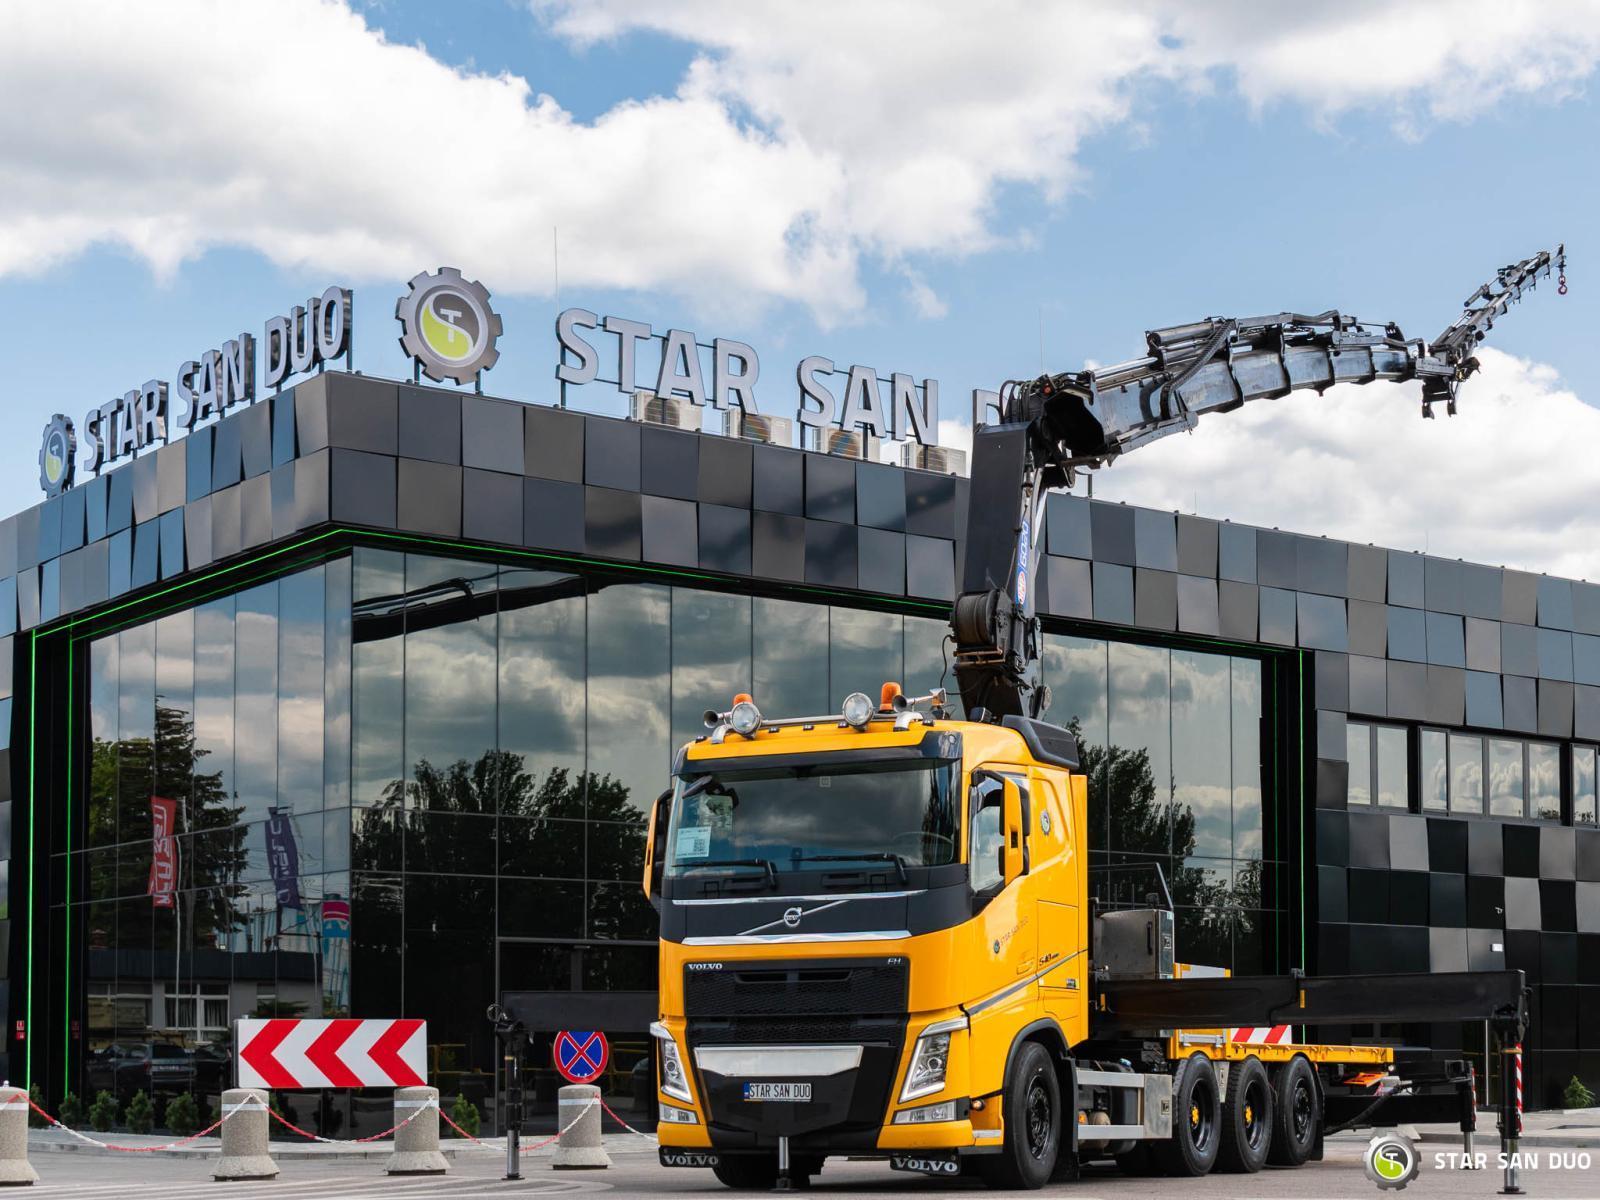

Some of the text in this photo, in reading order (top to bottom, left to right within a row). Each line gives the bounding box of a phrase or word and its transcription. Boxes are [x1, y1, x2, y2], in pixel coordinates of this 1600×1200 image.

[84, 286, 350, 471] STAR SAN DUO
[556, 308, 939, 446] STAR SAN
[688, 963, 723, 971] VOLVO
[887, 957, 902, 965] FH
[750, 1084, 811, 1098] STAR SAN DUO
[663, 1155, 719, 1166] VOLVO
[894, 1157, 958, 1173] VOLVO
